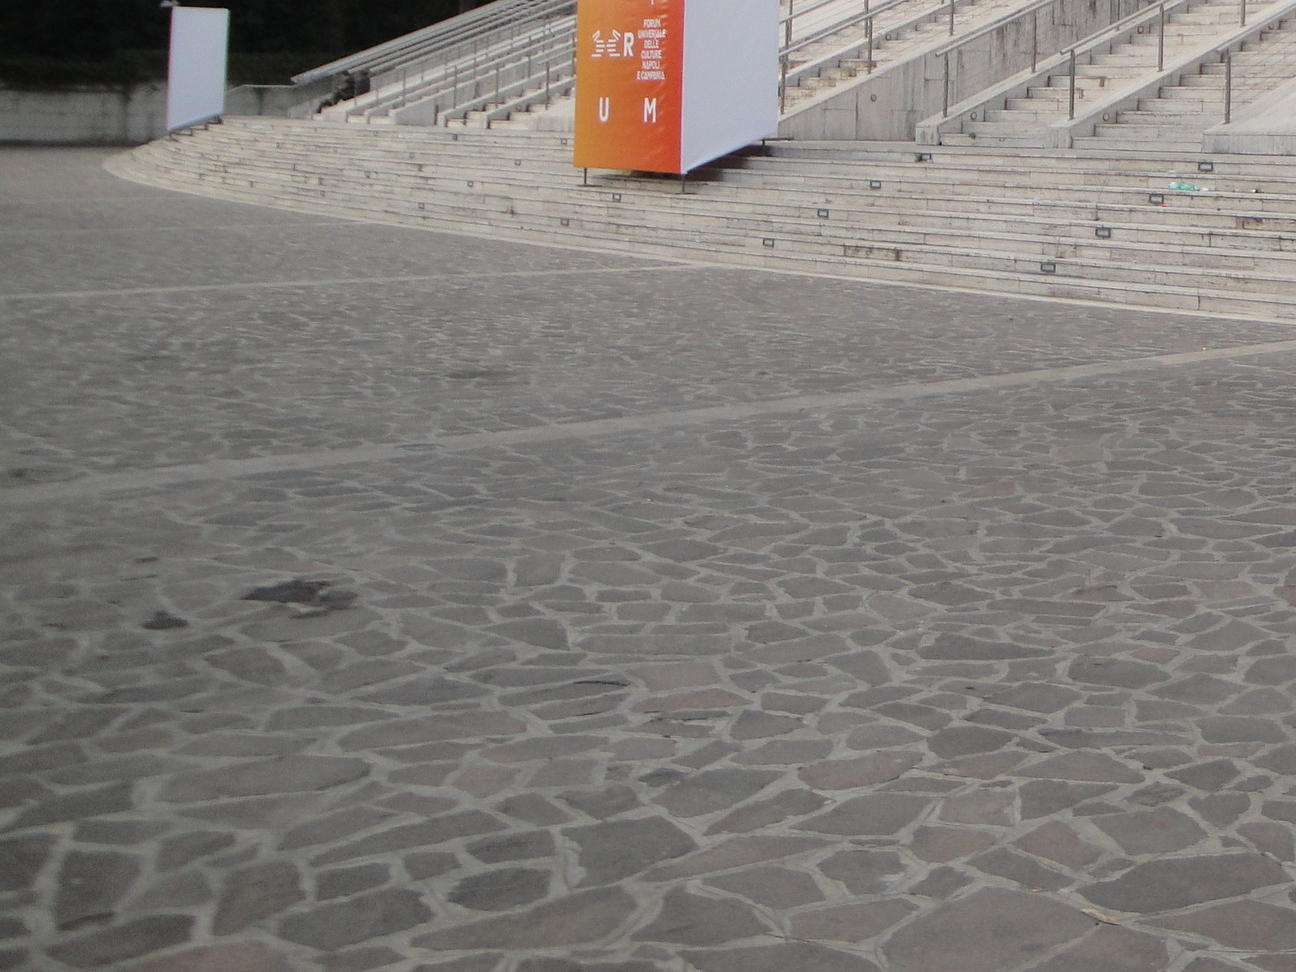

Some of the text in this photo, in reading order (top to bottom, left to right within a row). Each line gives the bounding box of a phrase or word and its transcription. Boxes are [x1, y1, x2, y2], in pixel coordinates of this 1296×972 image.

[644, 19, 661, 28] FORUM
[623, 32, 634, 57] R
[644, 40, 660, 48] DELLE
[641, 50, 662, 59] CULTURE
[642, 60, 660, 70] NAPOLI
[599, 97, 657, 123] U M
